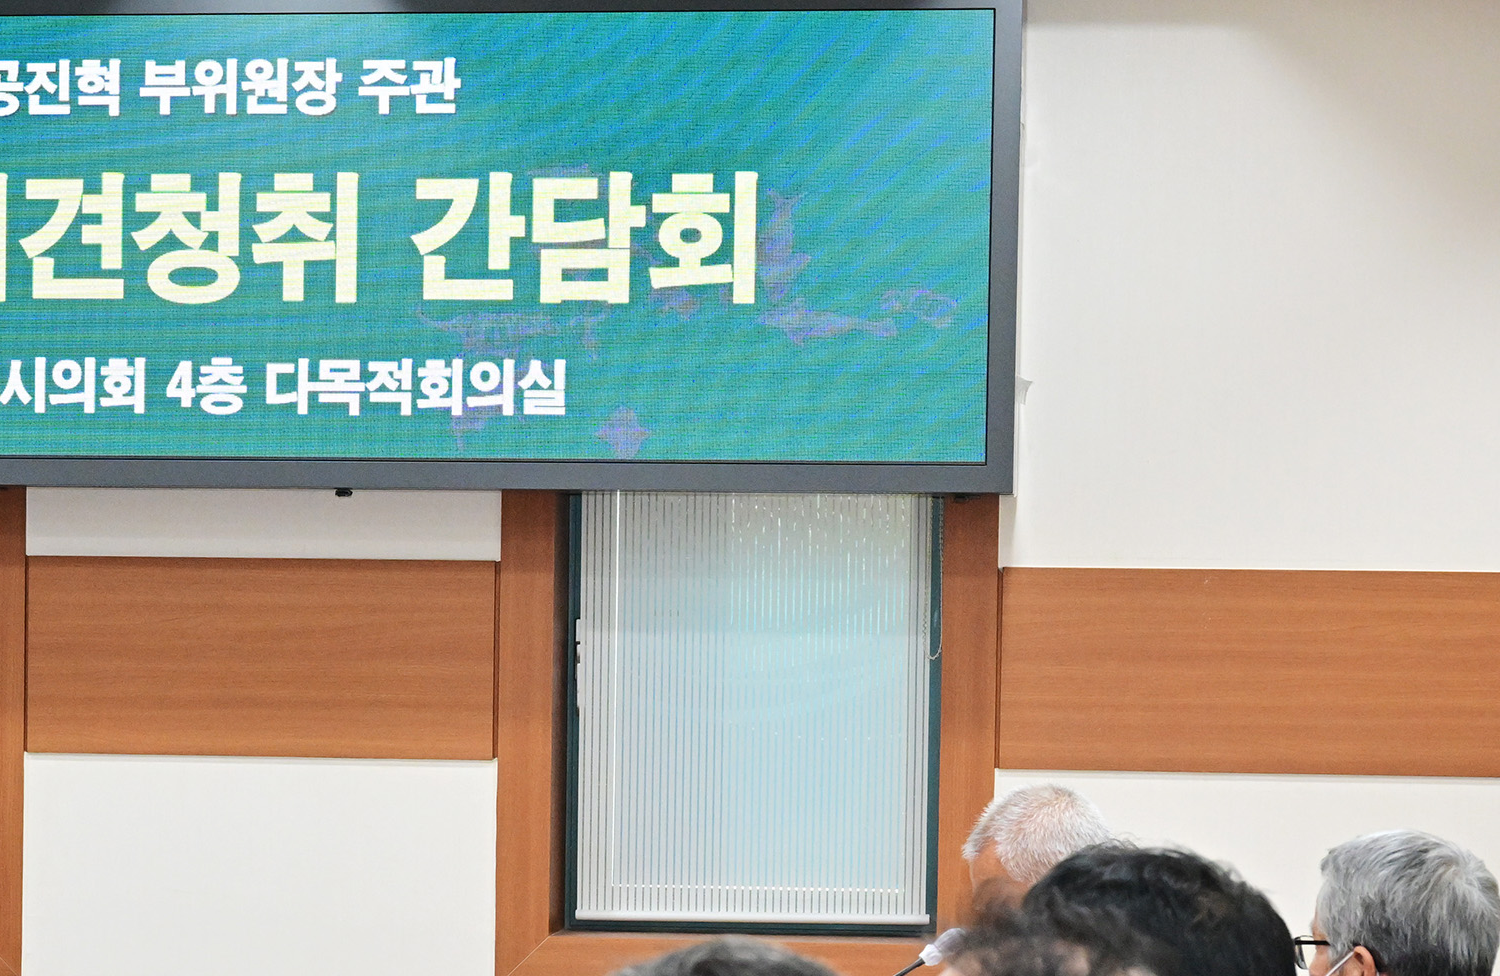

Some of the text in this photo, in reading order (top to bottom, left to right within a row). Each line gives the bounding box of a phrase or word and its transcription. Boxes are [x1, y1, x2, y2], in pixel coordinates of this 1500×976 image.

[139, 57, 343, 116] 부위원장
[358, 57, 462, 115] 주관
[411, 171, 759, 304] 간담회
[166, 357, 248, 415] 4층
[265, 357, 566, 416] 다목적회의실
